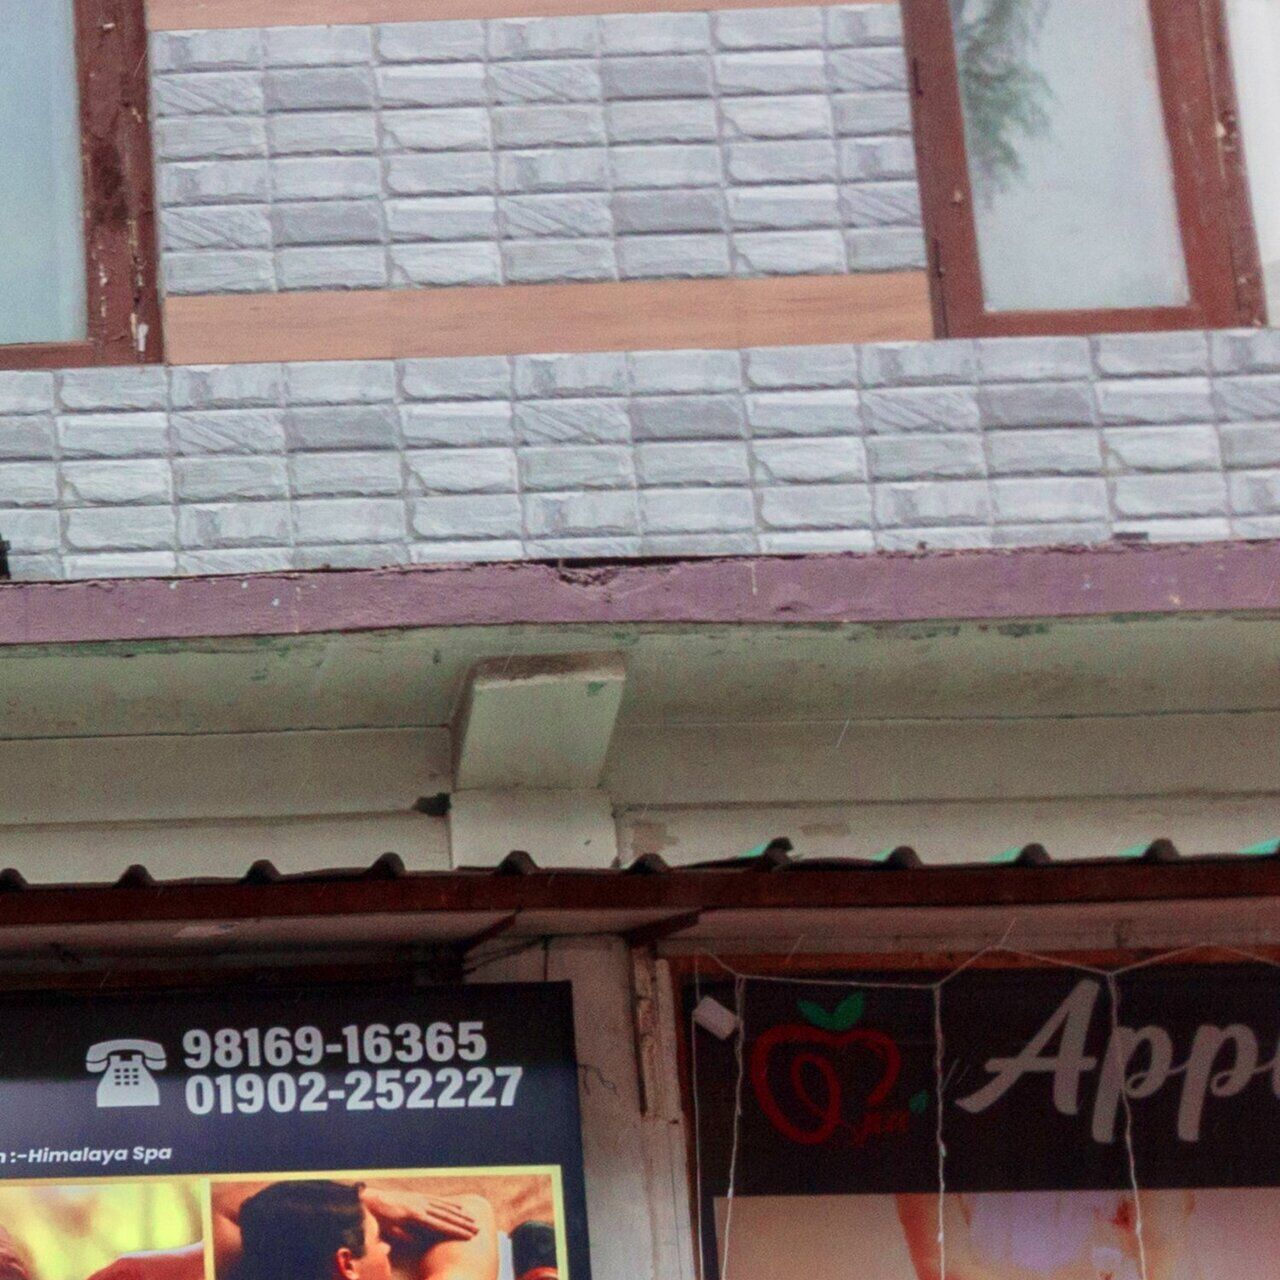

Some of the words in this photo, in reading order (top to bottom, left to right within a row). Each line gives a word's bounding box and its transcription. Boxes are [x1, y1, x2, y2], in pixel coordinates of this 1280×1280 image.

[182, 1021, 488, 1069] 98169-16365
[956, 979, 1280, 1143] App
[184, 1066, 524, 1115] 01902-252227
[132, 1146, 173, 1165] Spa
